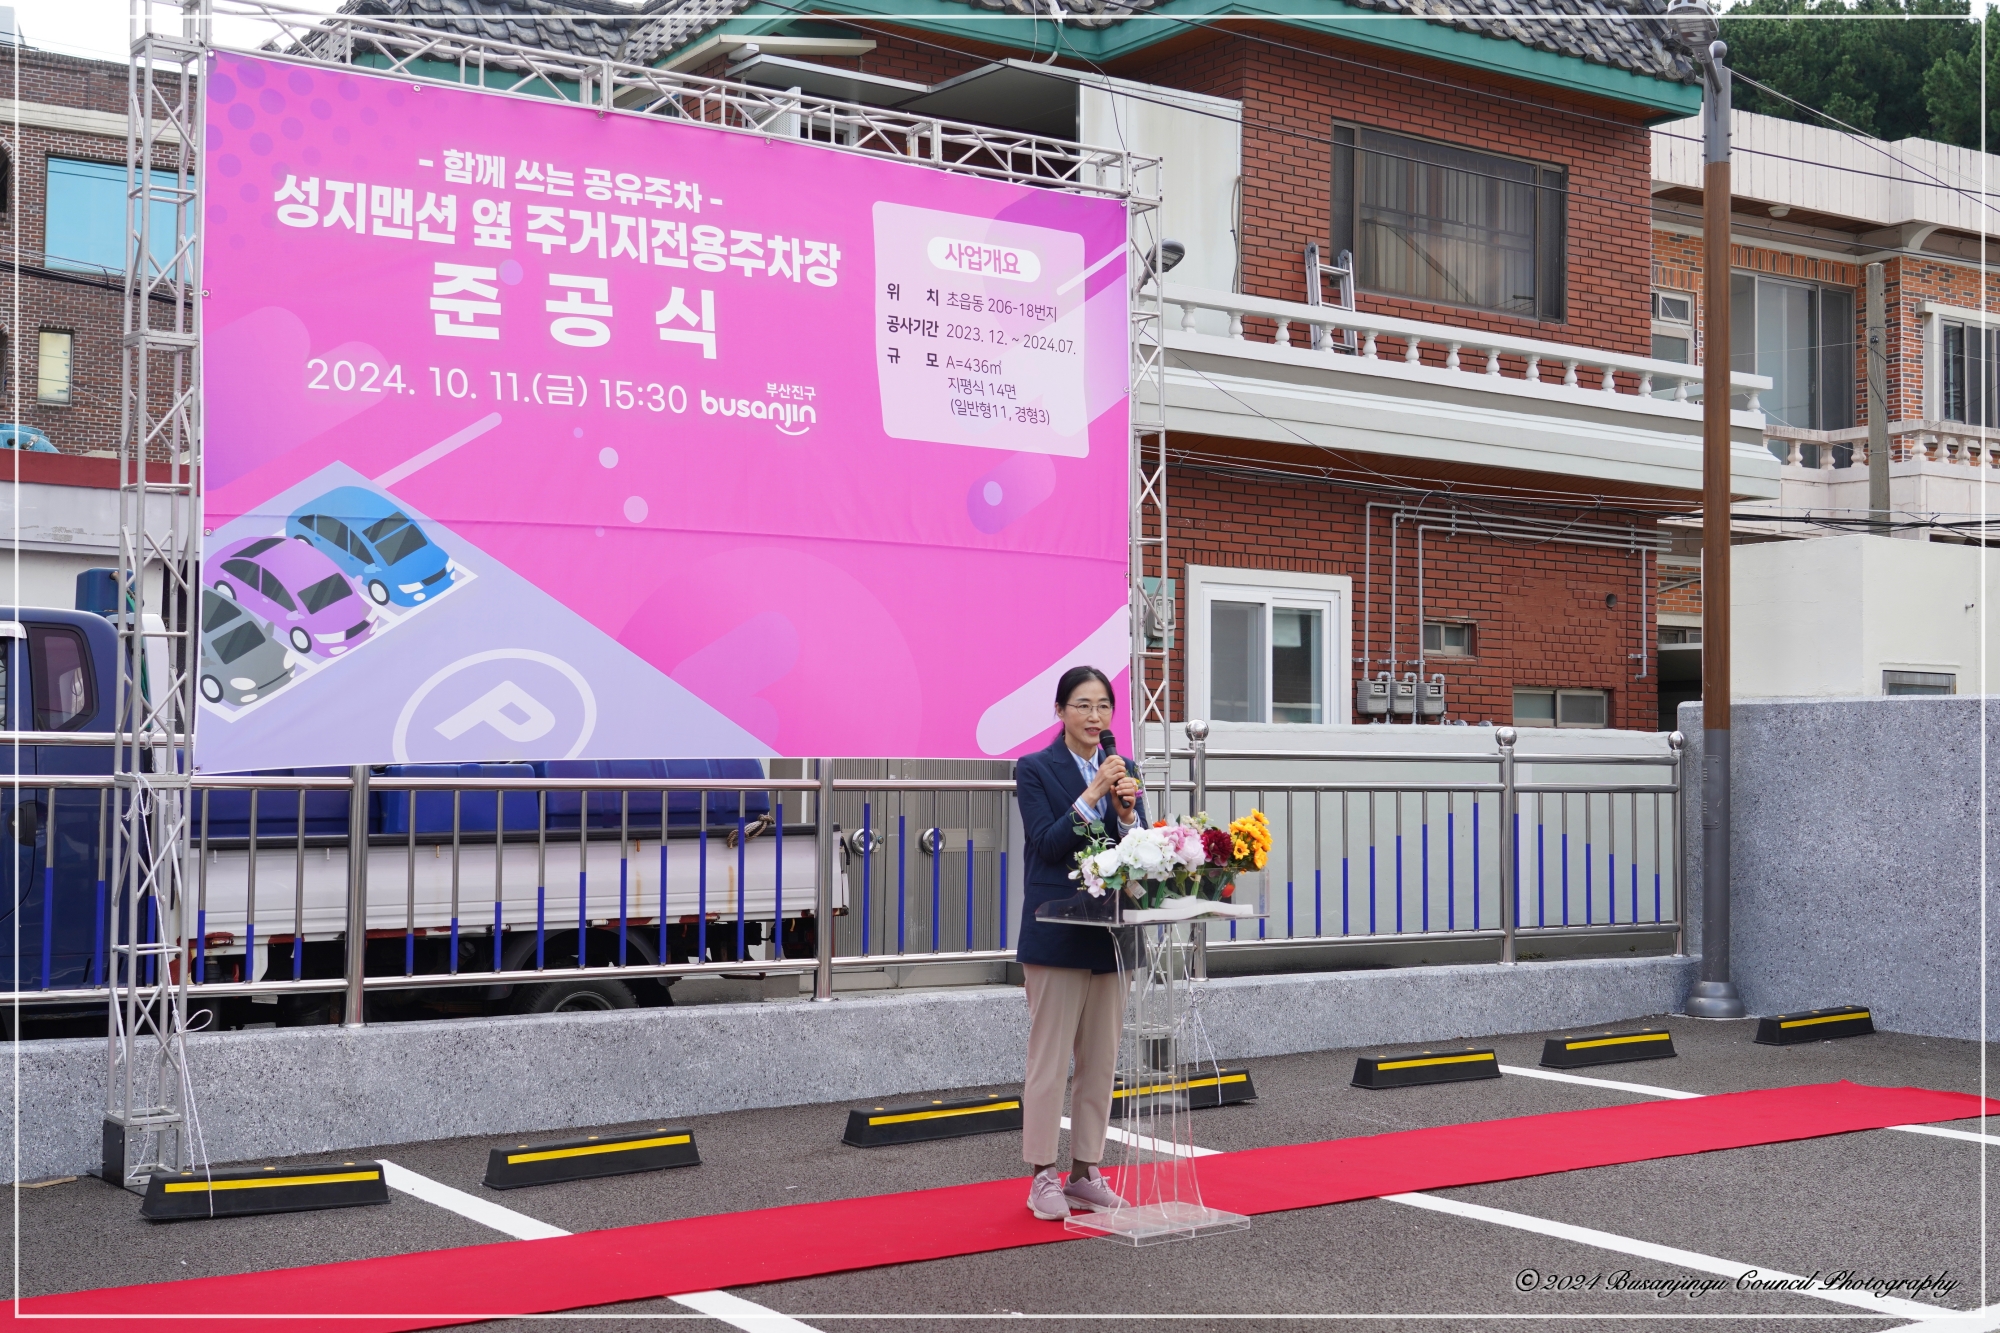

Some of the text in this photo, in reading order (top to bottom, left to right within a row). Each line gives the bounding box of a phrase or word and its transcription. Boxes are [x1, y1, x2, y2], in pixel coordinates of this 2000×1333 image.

[442, 149, 506, 188] 함께
[514, 160, 575, 196] 쓰는
[583, 167, 703, 213] 공유주차
[273, 173, 842, 288] 성지맨션 옆 주거지전용주차장
[944, 243, 1021, 274] 사업개요
[947, 292, 984, 312] 초읍동
[988, 298, 1057, 323] 206-18번지
[887, 315, 939, 337] 공사기간
[946, 324, 984, 342] 2023.
[989, 330, 1008, 345] 12.
[1024, 335, 1076, 355] 2024.07.
[307, 358, 416, 396] 2024.
[429, 366, 477, 400] 10.
[600, 380, 687, 415] 15:30
[766, 382, 817, 402] 부산진구
[948, 377, 1016, 400] 지평식 14면
[701, 389, 817, 429] busanjin
[951, 399, 1050, 425] (일반형11, 경형3)
